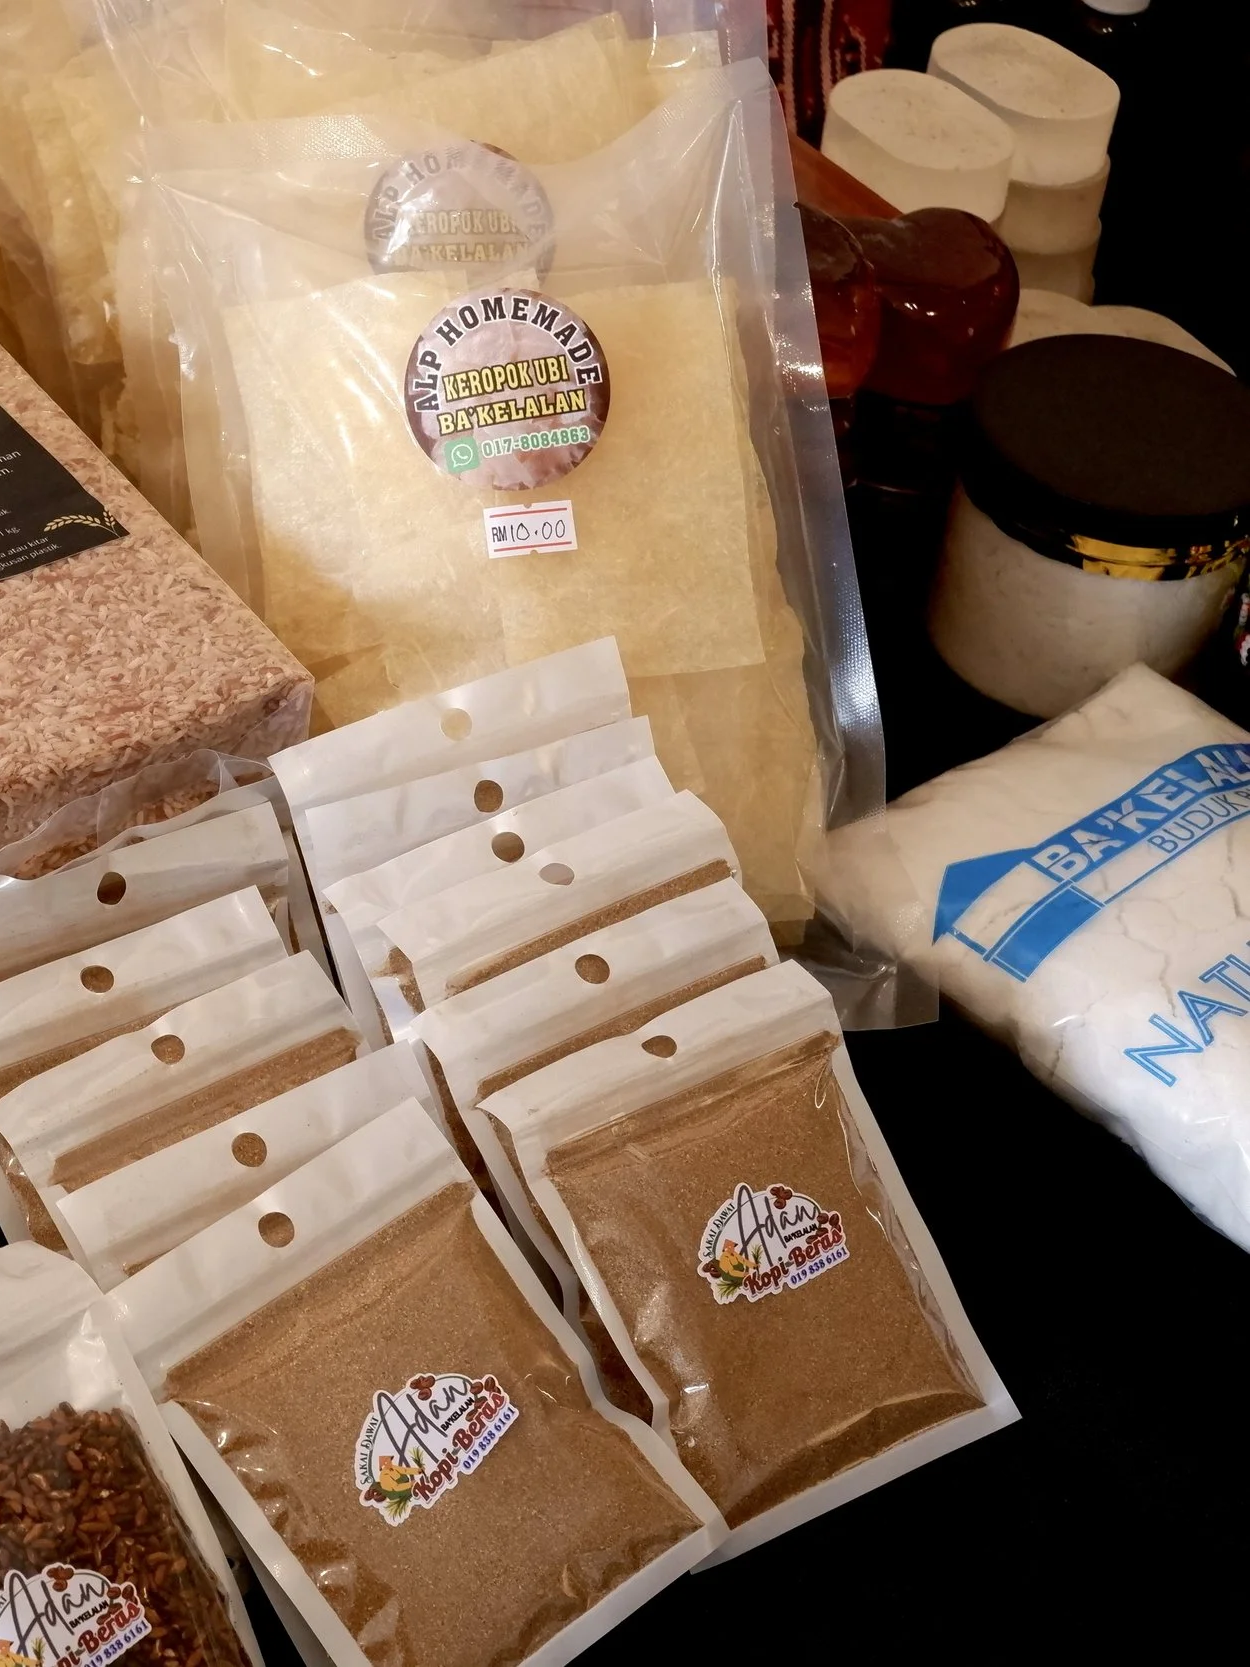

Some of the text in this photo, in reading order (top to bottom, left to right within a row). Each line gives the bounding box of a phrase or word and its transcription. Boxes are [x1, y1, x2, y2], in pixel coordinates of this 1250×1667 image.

[415, 297, 602, 412] ALP HOMEMADE
[442, 355, 569, 402] KEROPOK UBI
[437, 389, 586, 436] BA'KELALAN
[482, 426, 590, 458] 017-8084863
[1148, 794, 1248, 854] BUDUK
[703, 1203, 735, 1257] SAKAI DAWAT
[791, 1246, 848, 1285] 019 838 6161
[360, 1417, 379, 1485] SAKAI DAWAT
[463, 1407, 516, 1470] 019 838 6161
[104, 1620, 148, 1659] 838 6161
